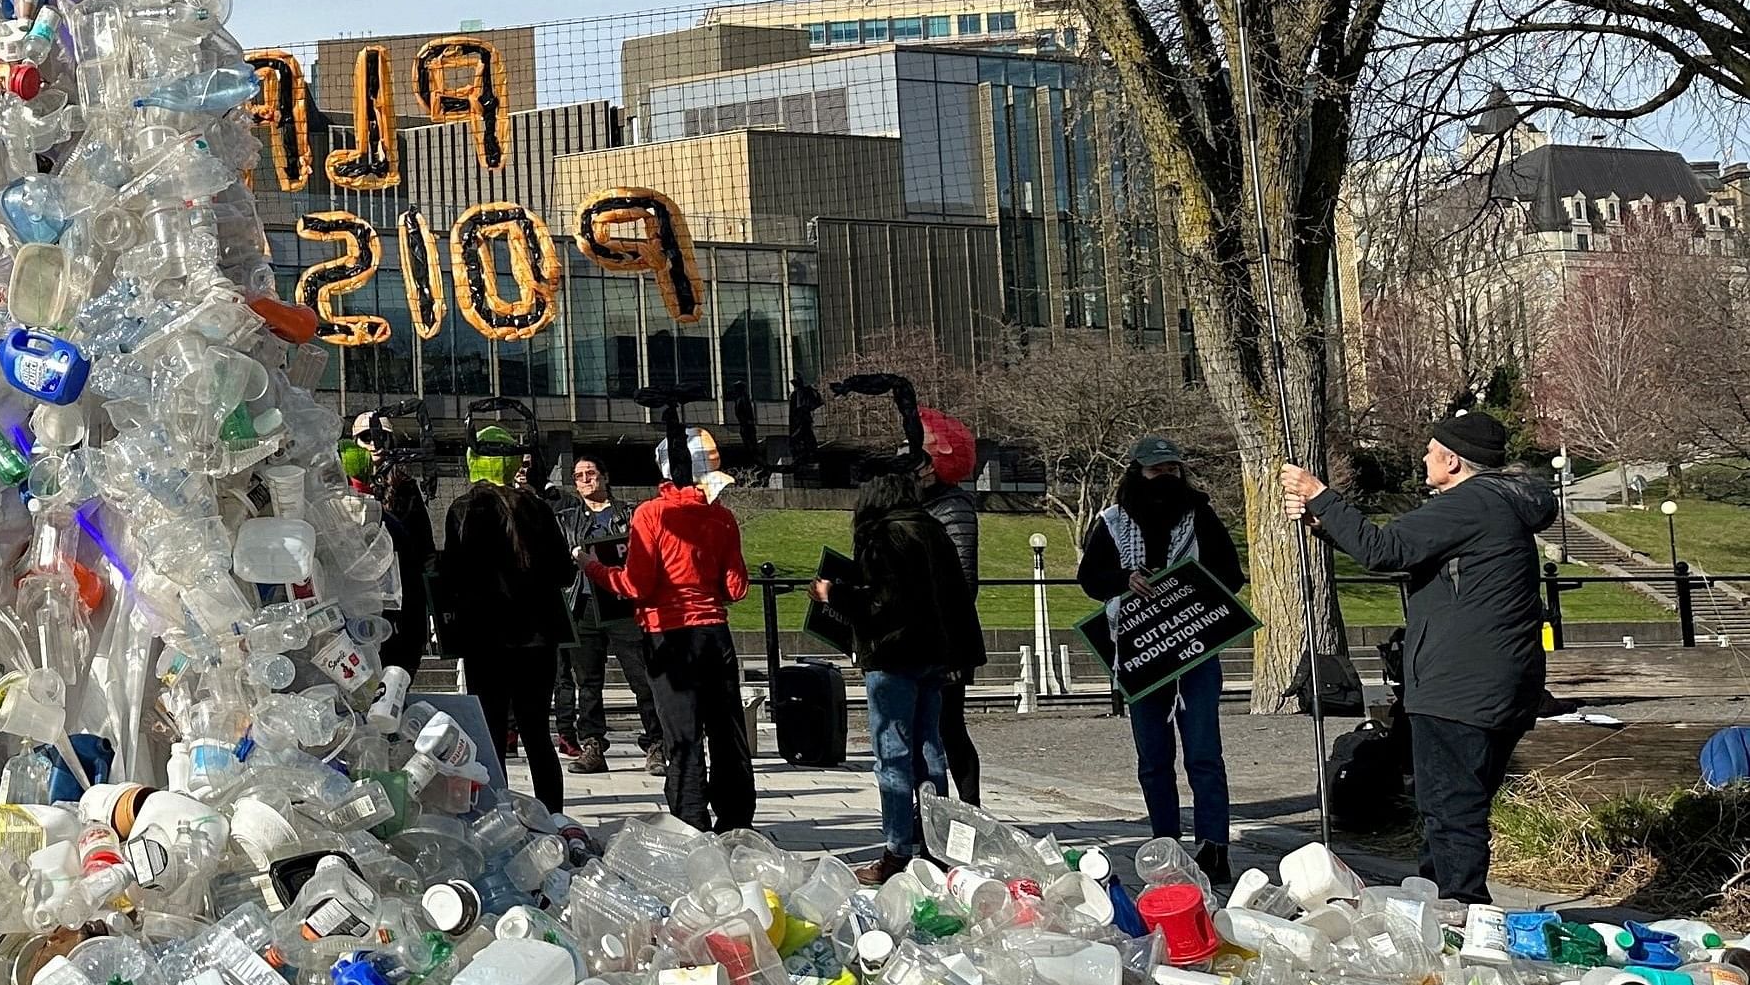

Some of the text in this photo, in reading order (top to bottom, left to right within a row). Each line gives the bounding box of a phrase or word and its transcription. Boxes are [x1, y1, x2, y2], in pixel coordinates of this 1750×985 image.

[1117, 583, 1197, 636] CLIMATE CHAOS:
[1118, 597, 1142, 619] TOP
[1132, 601, 1206, 649] CUT PLASTIC
[1123, 604, 1231, 673] PRODUCTION NOW
